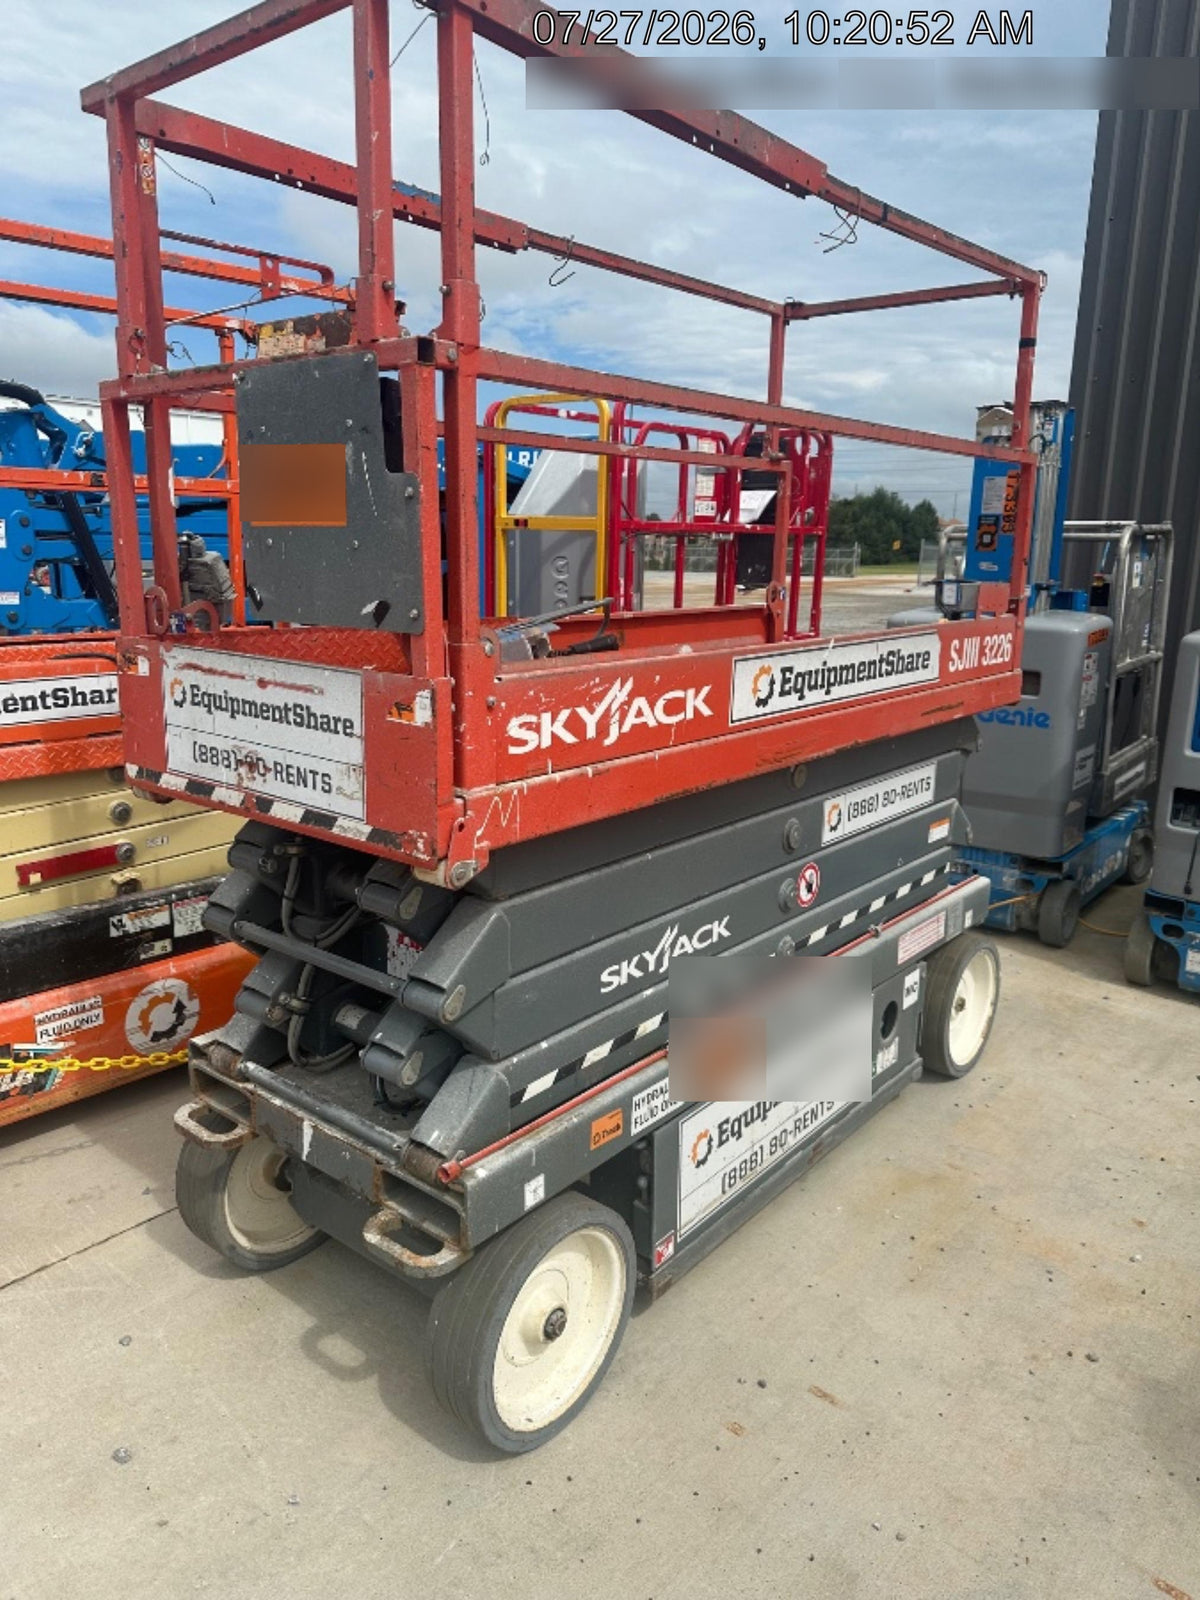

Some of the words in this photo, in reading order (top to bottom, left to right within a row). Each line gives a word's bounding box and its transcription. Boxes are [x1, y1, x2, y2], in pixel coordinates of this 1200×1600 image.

[778, 647, 931, 700] EquipmentShare
[982, 632, 1013, 667] 3226
[0, 686, 118, 714] entShar
[189, 684, 355, 738] EquipmentShare
[506, 676, 714, 755] SKYJACK
[193, 741, 240, 772] (888)
[847, 793, 879, 822] (888)
[881, 776, 932, 808] 80-RENTS
[600, 915, 732, 993] SKYJACK
[721, 1144, 764, 1195] (888)
[769, 1101, 835, 1157] 80-RENTS
